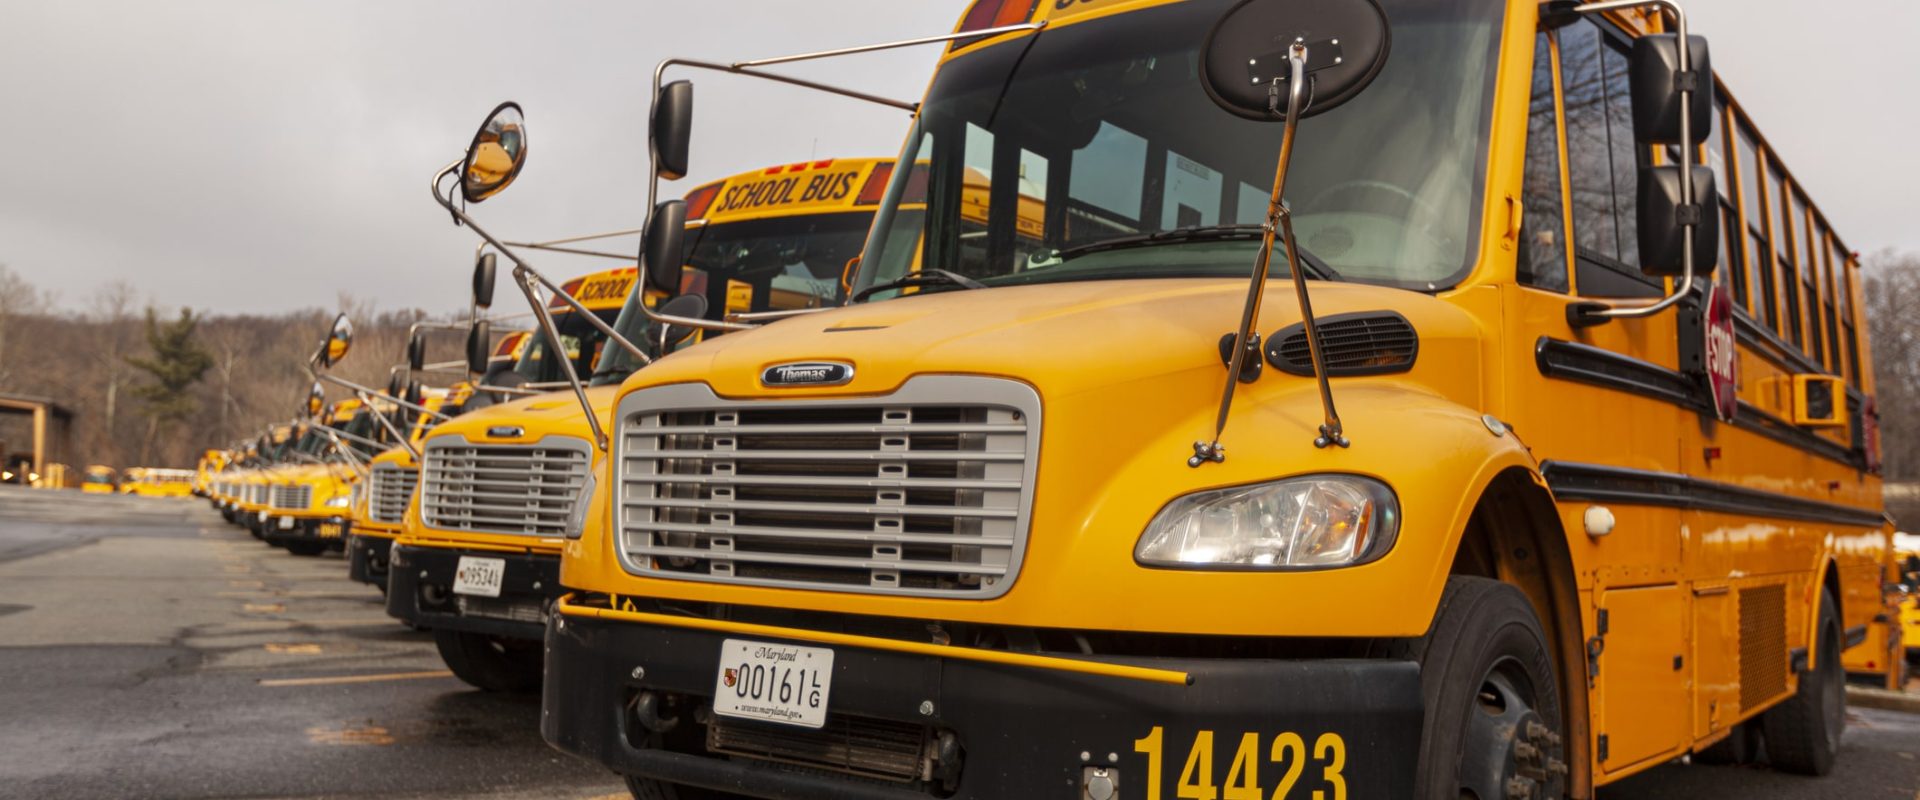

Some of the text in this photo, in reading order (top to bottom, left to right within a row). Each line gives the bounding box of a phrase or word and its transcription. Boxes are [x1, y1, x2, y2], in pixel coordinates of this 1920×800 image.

[716, 171, 858, 213] SCHOOL BUS
[578, 277, 632, 301] SCHOOL
[754, 646, 799, 664] Maryland
[736, 662, 806, 706] 00161
[741, 703, 799, 719] www.maryland.gov
[1133, 726, 1348, 800] 14423
